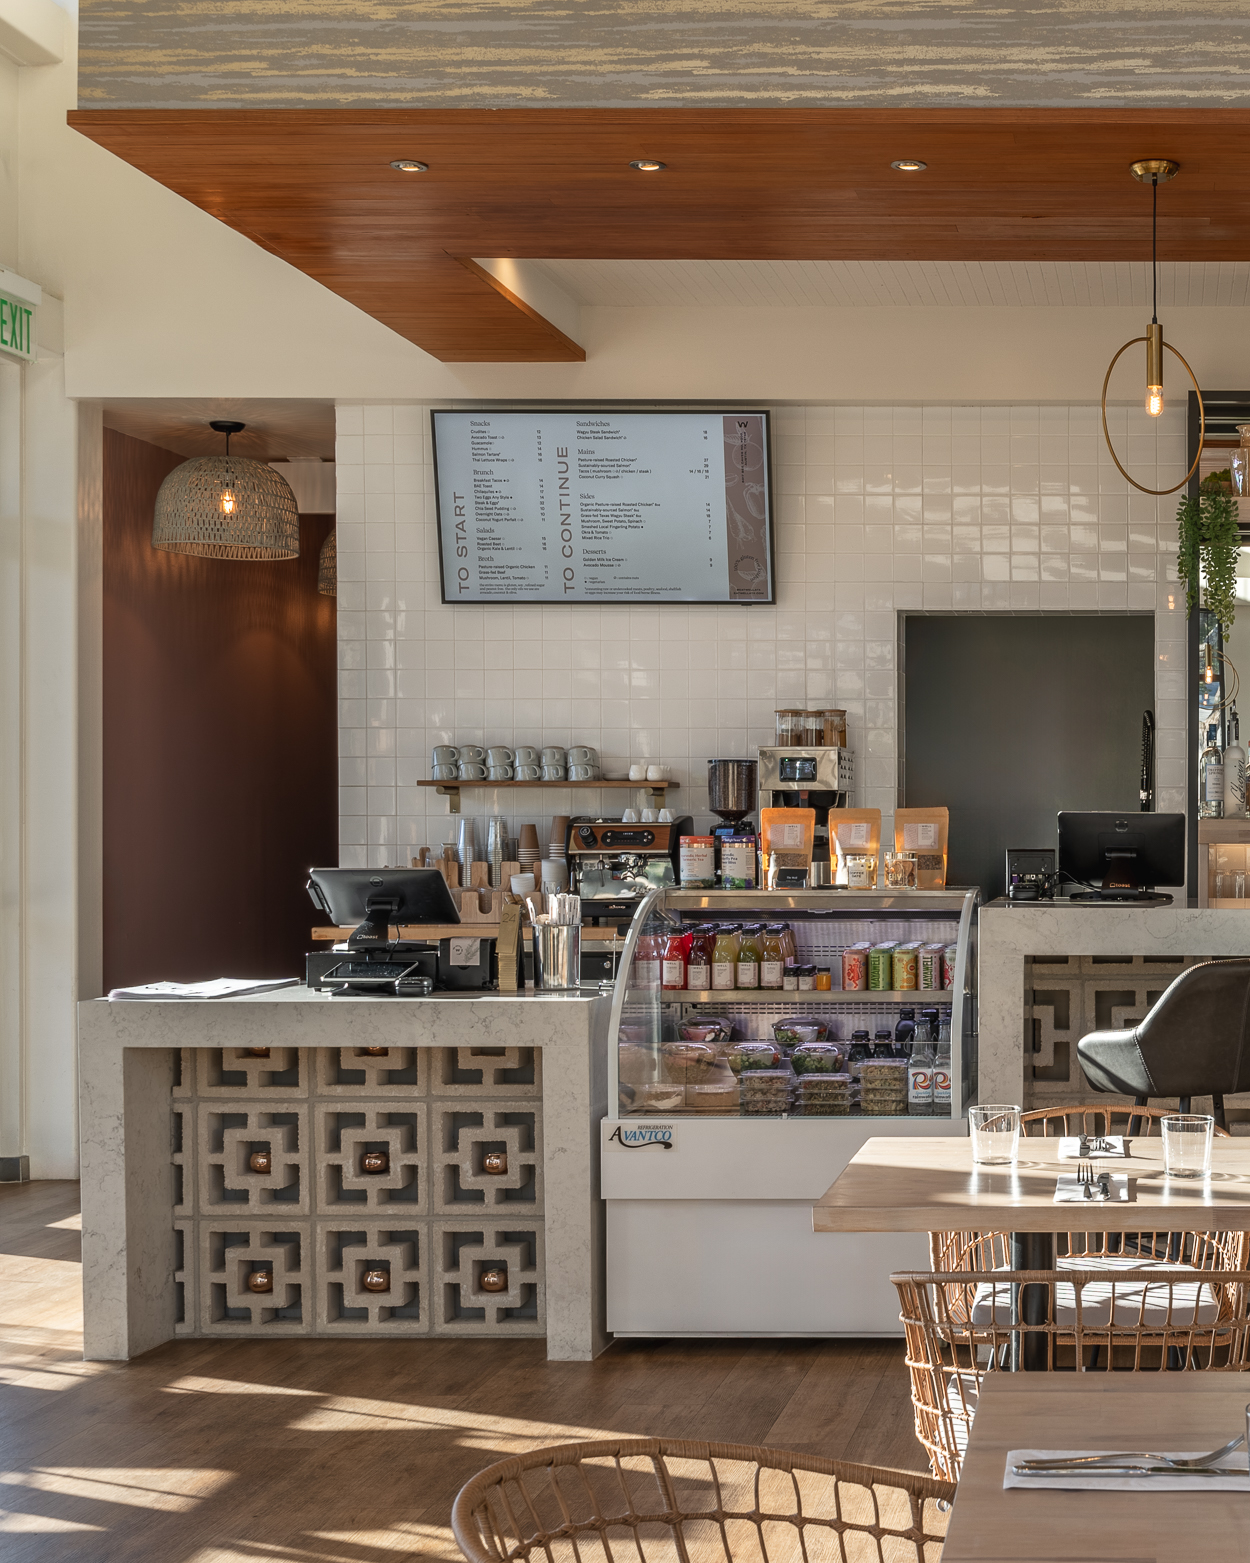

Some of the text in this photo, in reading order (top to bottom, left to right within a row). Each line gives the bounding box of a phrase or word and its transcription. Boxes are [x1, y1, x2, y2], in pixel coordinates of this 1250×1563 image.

[0, 298, 32, 354] EXIT
[557, 446, 575, 594] TO CONTINUE
[453, 491, 470, 594] TO START
[1230, 758, 1245, 803] Chopin
[502, 913, 516, 923] 24
[871, 956, 880, 989] MAYAWELL
[923, 956, 933, 989] MAYAWELL
[608, 1125, 672, 1142] AVANTCO
